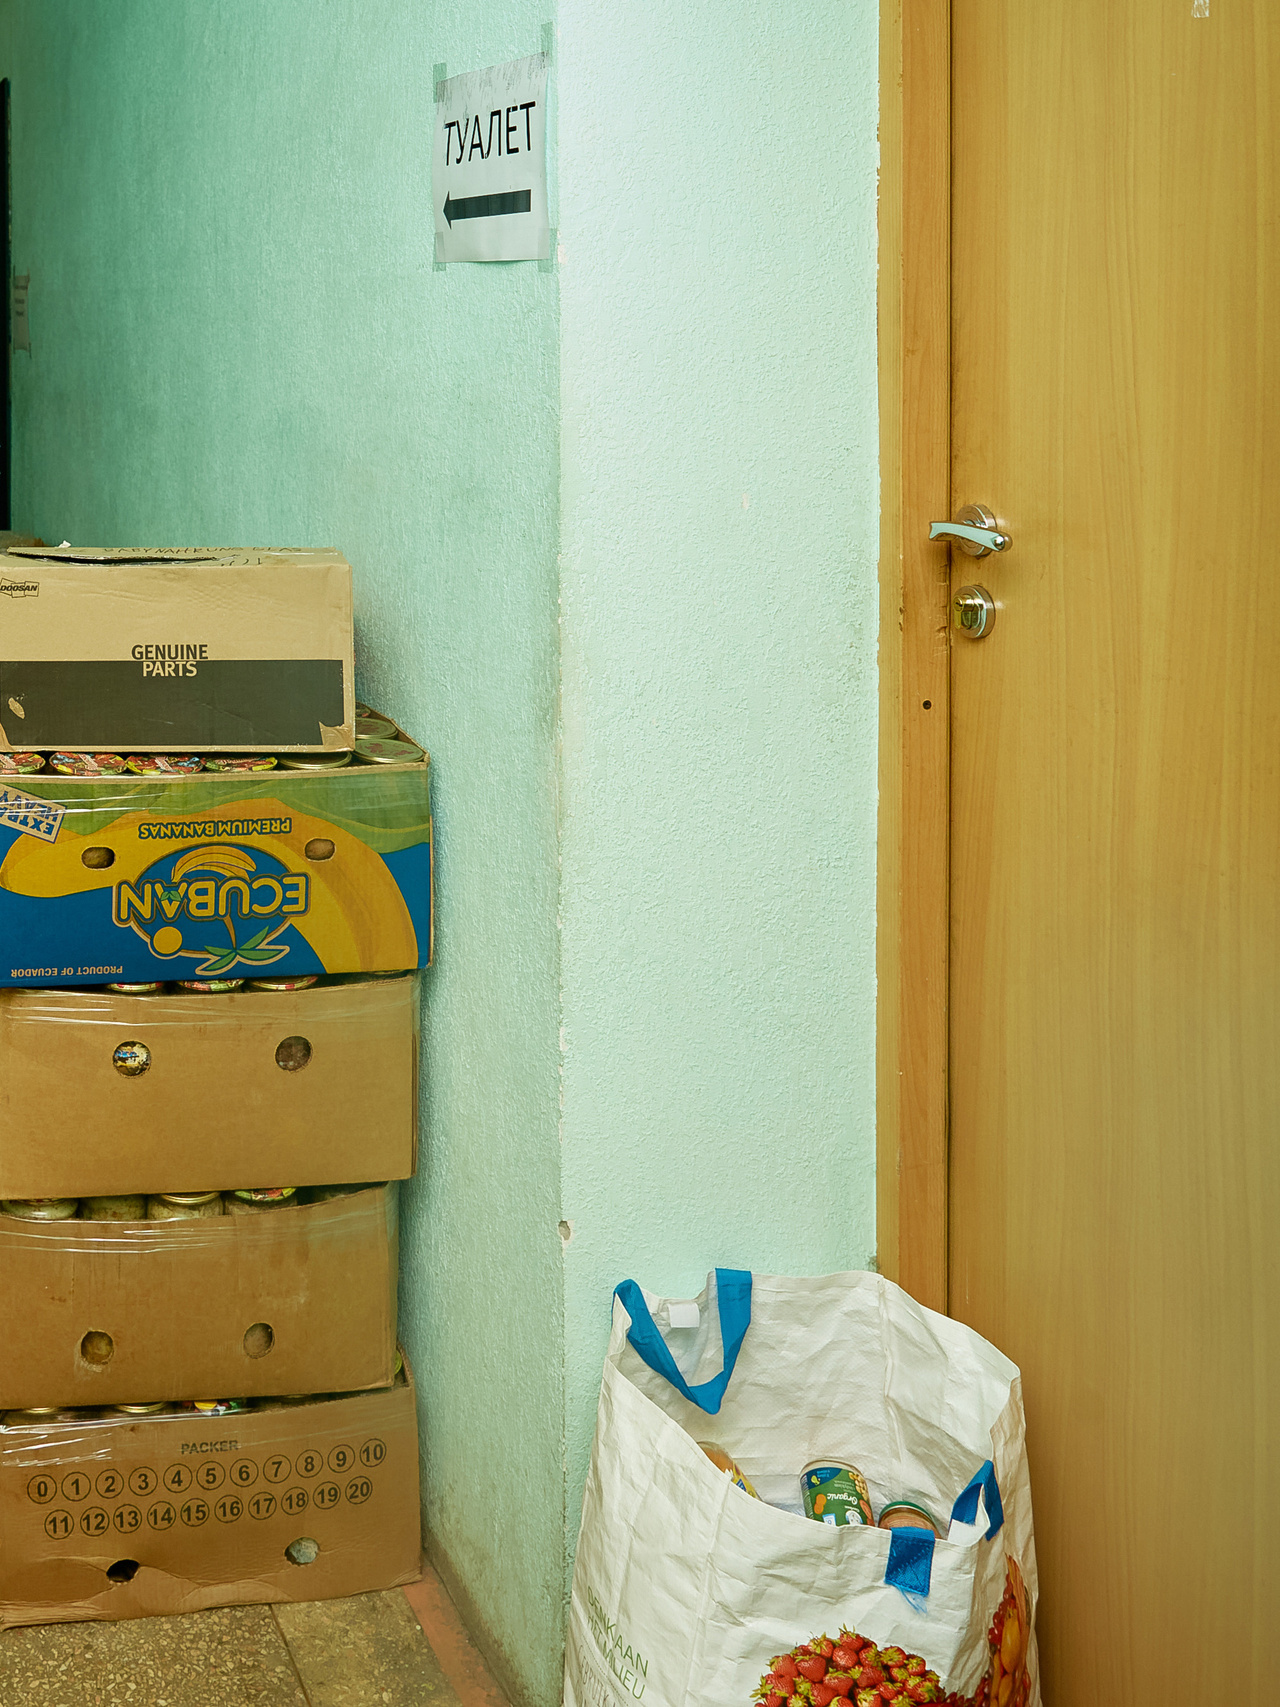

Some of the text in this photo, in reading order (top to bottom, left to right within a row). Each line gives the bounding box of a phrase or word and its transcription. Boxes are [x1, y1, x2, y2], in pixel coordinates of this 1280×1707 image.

[444, 101, 536, 167] ТУАЛЕТ
[0, 584, 38, 593] DOOSAN
[131, 644, 209, 660] GENUINE
[142, 661, 198, 677] PARTS
[139, 818, 291, 839] PREMIUM BANANAS
[119, 874, 308, 921] ECUBAN
[11, 965, 123, 978] PRODUCT OF ECUADOR
[180, 1439, 240, 1455] PACKER
[38, 1444, 383, 1497] 0 1 2 3 4 5 6 7 8 9 10
[49, 1481, 370, 1533] 11 12 13 14 15 16 17 18 19 20
[826, 1492, 858, 1505] Organic
[587, 1585, 649, 1678] DENK AAN
[602, 1640, 645, 1700] MILIEU
